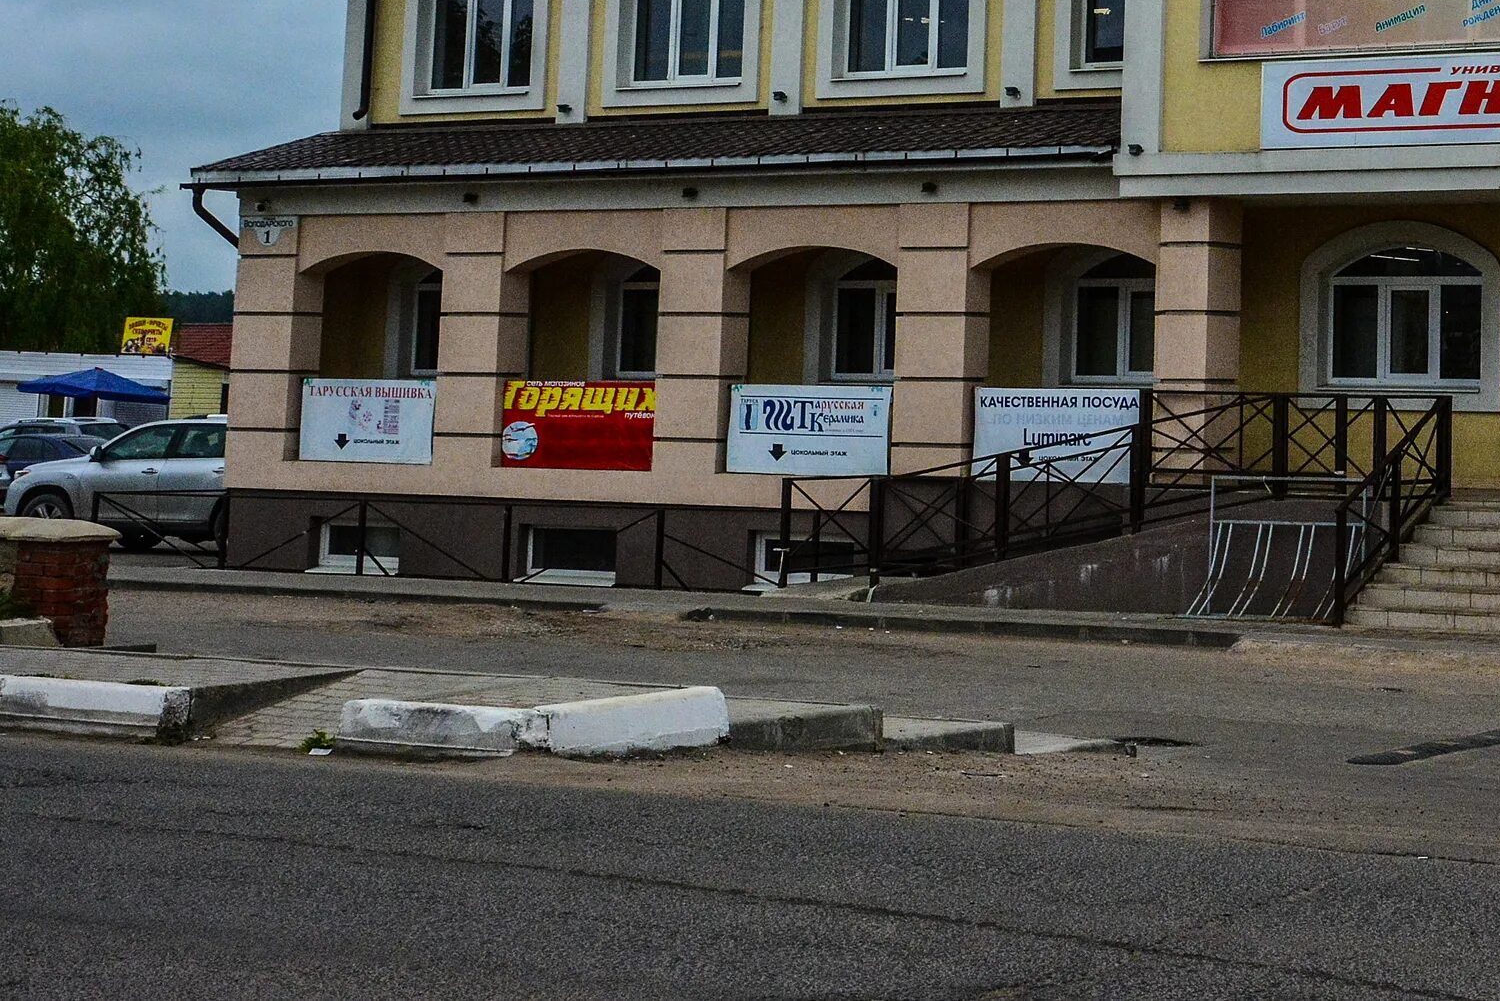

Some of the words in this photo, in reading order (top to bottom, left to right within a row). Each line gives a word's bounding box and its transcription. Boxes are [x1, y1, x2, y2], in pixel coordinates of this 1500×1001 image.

[1375, 4, 1426, 33] Анимация
[263, 229, 271, 244] 1
[309, 385, 373, 398] ТАРУССКАЯ
[375, 386, 433, 399] ВЫШИВКА
[503, 381, 656, 417] Горящих
[980, 396, 1078, 408] КАЧЕСТВЕННАЯ
[1082, 396, 1139, 410] ПОСУДА
[1023, 428, 1092, 447] Luminarc
